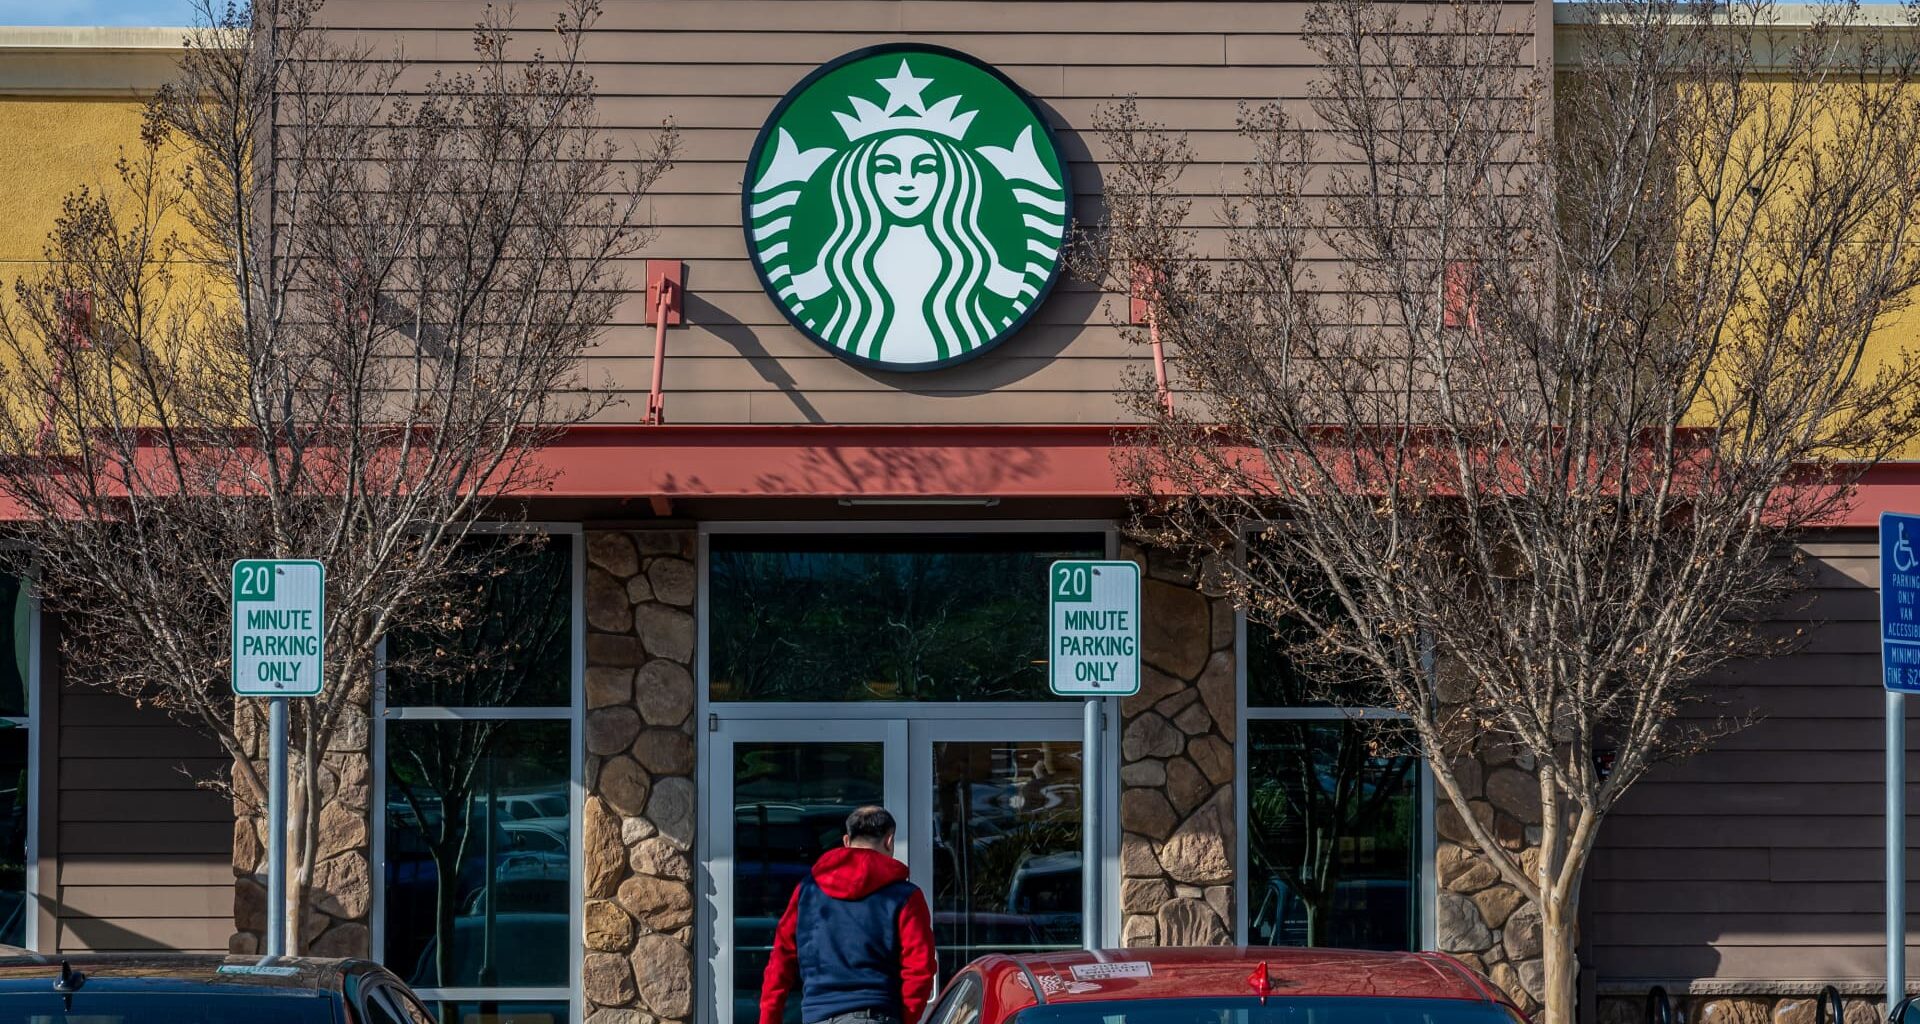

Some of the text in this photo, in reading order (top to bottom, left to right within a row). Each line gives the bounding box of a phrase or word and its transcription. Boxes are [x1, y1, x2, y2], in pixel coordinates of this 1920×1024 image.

[241, 566, 270, 595] 20
[1058, 567, 1087, 596] 20
[1898, 590, 1915, 605] ONLY
[247, 609, 312, 630] MINUTE
[1064, 610, 1129, 631] MINUTE
[1900, 606, 1913, 621] VAN
[1888, 622, 1920, 638] ACCESSIB
[242, 635, 318, 656] PARKING
[1060, 635, 1134, 656] PARKING
[257, 661, 302, 682] ONLY
[1075, 661, 1119, 682] ONLY
[1887, 666, 1920, 686] FINE $2
